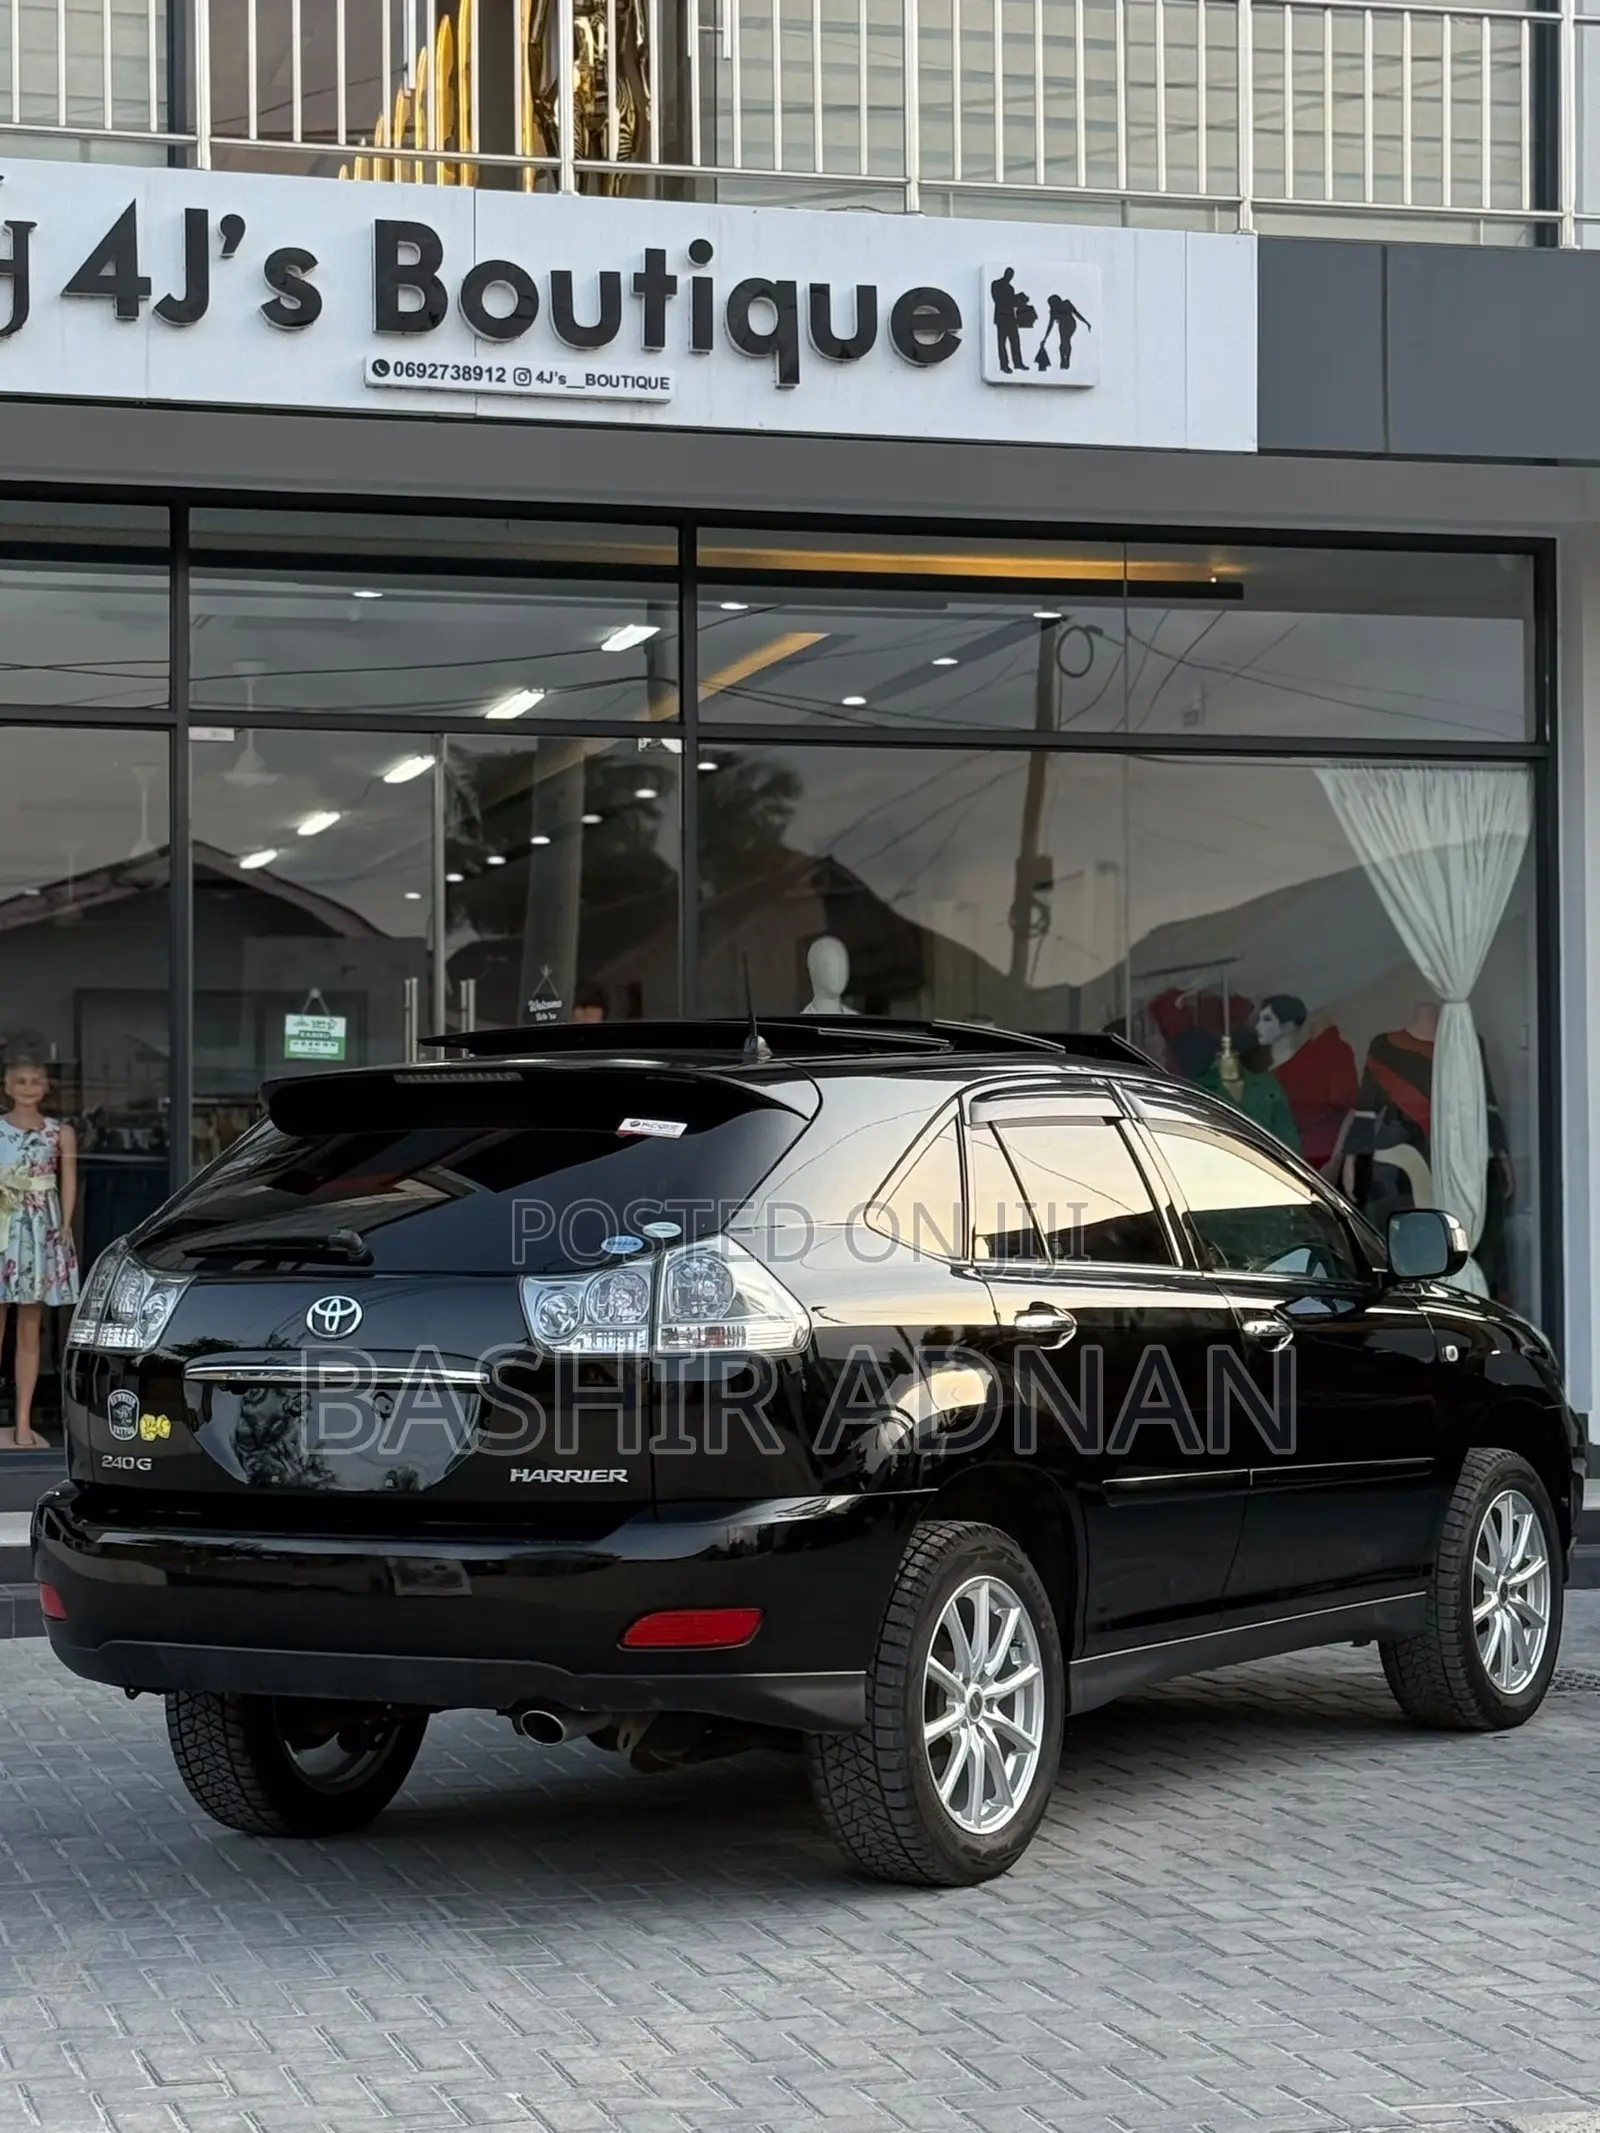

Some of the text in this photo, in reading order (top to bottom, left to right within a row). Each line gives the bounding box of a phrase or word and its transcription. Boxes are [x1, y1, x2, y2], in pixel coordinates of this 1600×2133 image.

[60, 197, 323, 331] 4J's
[371, 218, 964, 390] Boutique
[393, 361, 507, 383] 0692738912
[509, 1467, 629, 1484] HARRIER
